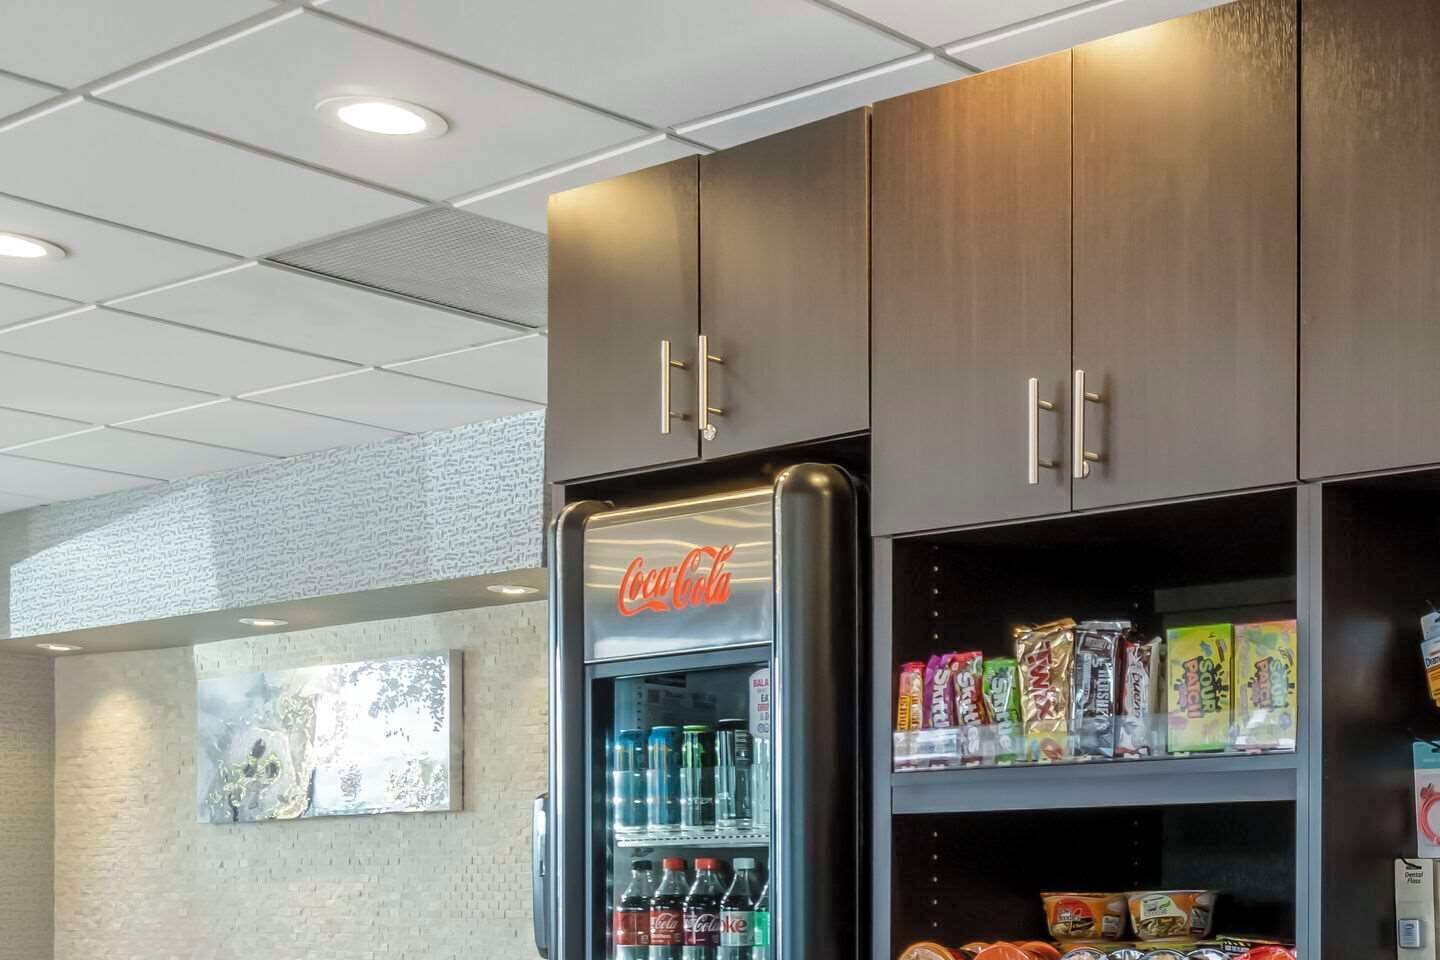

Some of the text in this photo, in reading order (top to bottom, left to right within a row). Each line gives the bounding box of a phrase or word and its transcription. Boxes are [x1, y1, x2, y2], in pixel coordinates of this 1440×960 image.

[618, 544, 735, 616] Coca-Cola
[933, 669, 950, 728] Skittl
[1201, 659, 1217, 712] SOUR
